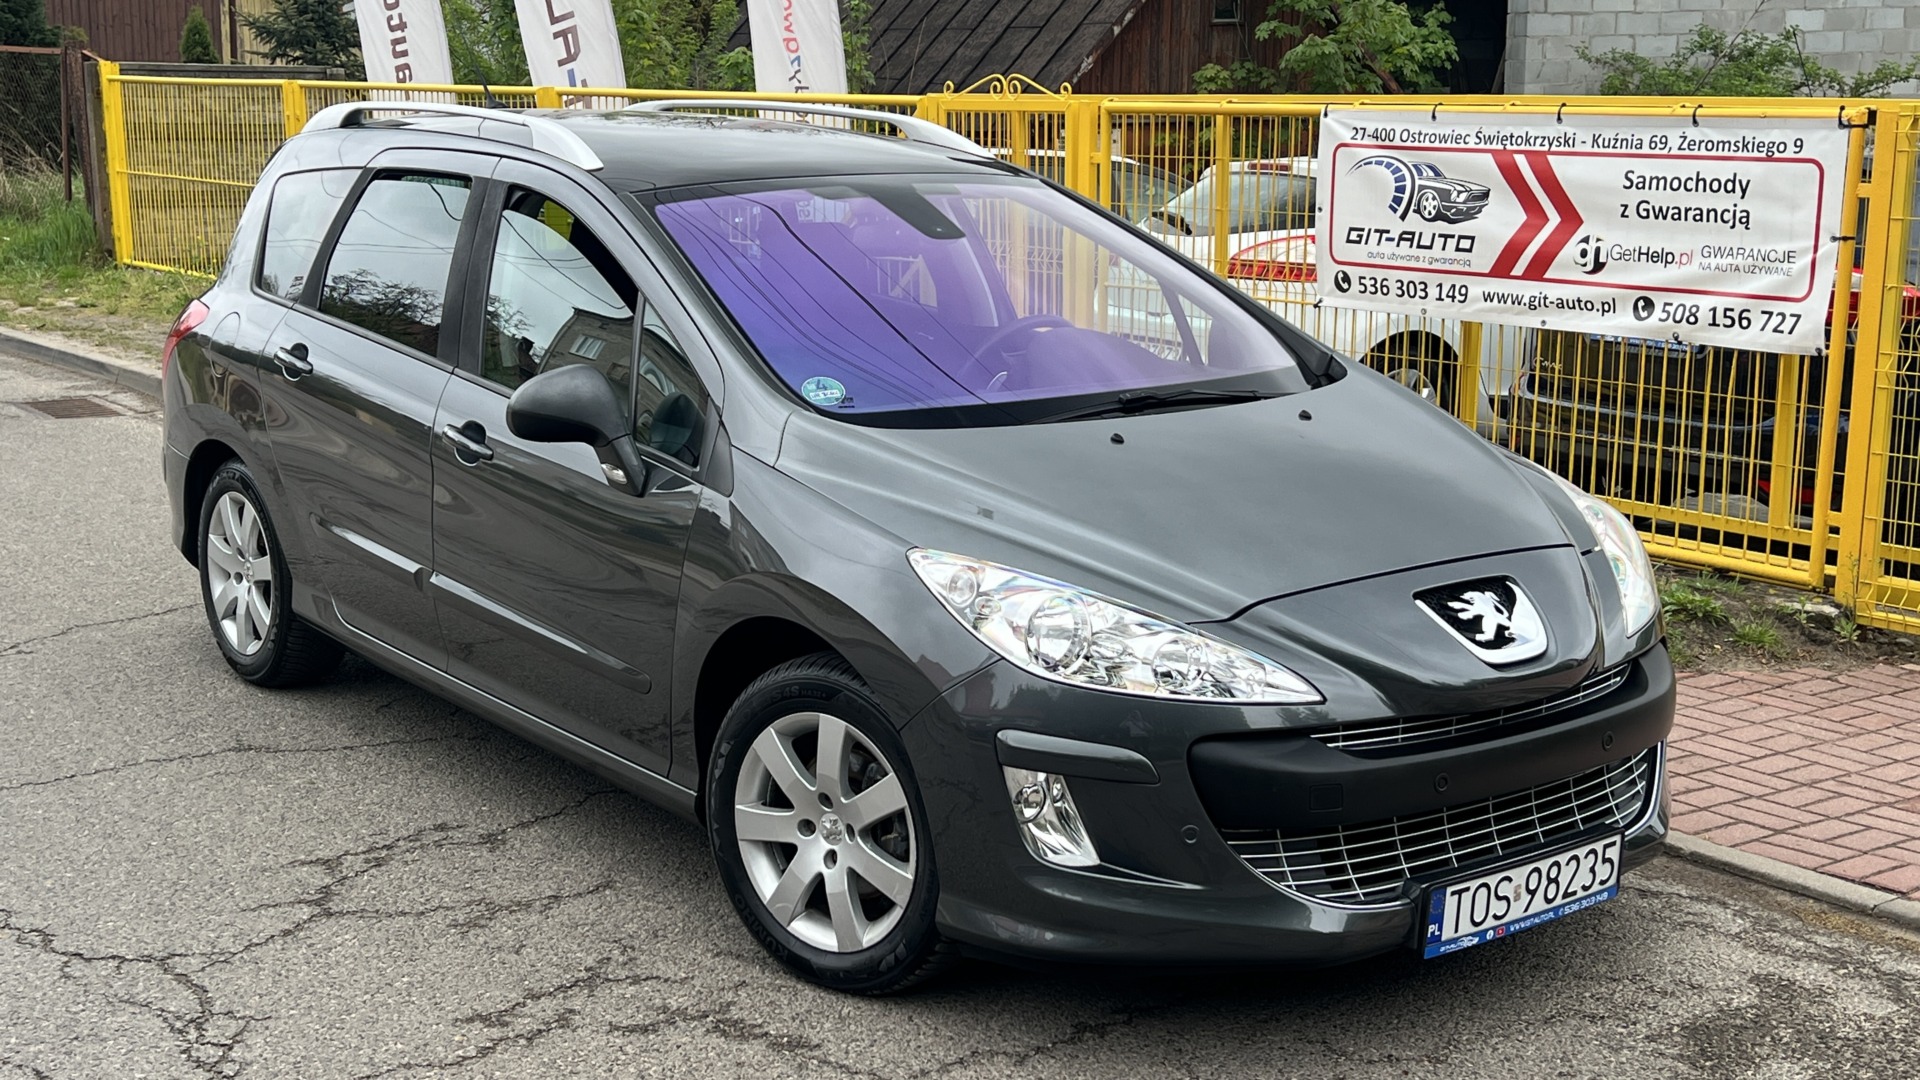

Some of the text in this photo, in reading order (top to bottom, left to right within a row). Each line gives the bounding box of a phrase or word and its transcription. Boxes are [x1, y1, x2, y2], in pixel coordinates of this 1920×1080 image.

[1350, 126, 1396, 143] 27-400
[1399, 128, 1471, 145] Ostrowiec
[1474, 127, 1576, 151] Świętokrzyski
[1591, 132, 1643, 150] Kuźnia
[1648, 135, 1673, 153] 69,
[1678, 131, 1788, 157] Żeromskiego
[1793, 137, 1804, 154] 9
[1622, 169, 1751, 200] Samochody
[1620, 199, 1751, 230] z Gwarancją
[1345, 226, 1476, 253] GIT-AUTO
[1367, 250, 1471, 267] auta używane z gwarancją
[1610, 243, 1694, 268] GetHelp.pl
[1701, 244, 1797, 264] GWARANCJE
[1698, 261, 1793, 277] NA AUTA UŻYWANE
[1358, 275, 1469, 304] 536 303 149
[1482, 289, 1616, 317] www.git-auto.pl
[1658, 301, 1802, 335] 508 156 727
[1449, 840, 1617, 934] TOS 98235
[1427, 924, 1441, 938] PL
